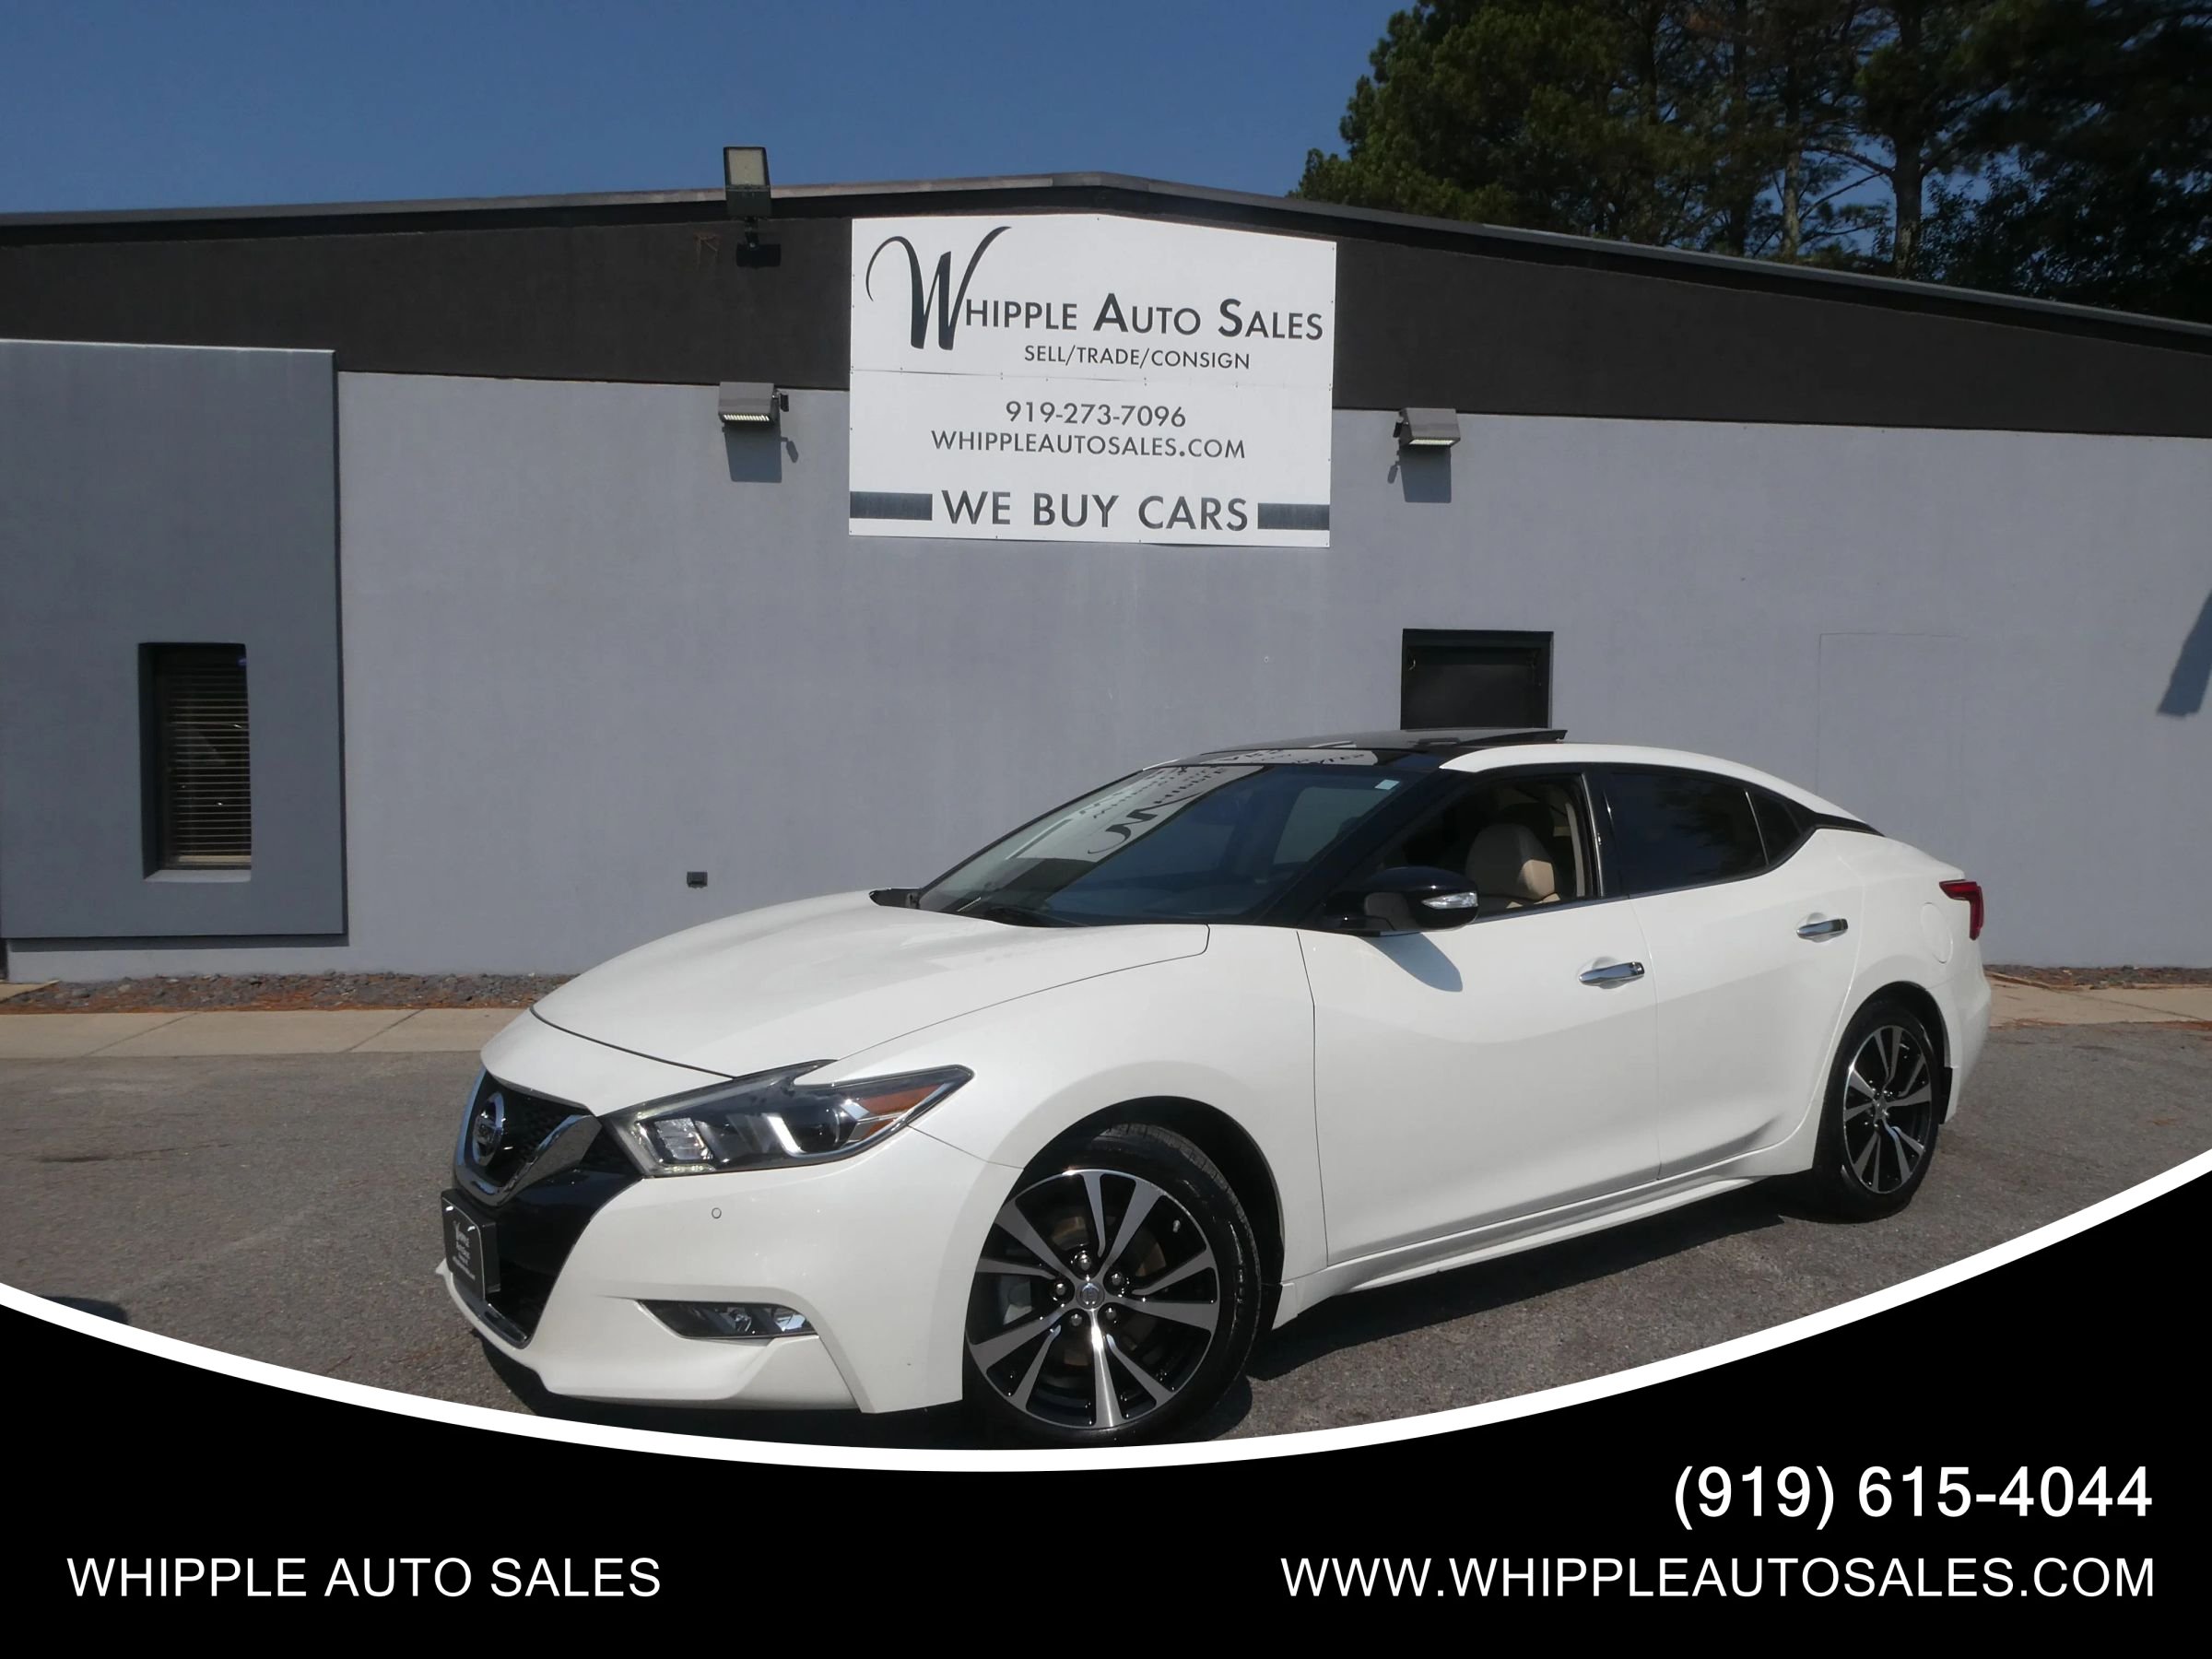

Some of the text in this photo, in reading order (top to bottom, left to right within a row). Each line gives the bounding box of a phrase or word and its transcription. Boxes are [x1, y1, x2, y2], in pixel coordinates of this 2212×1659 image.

[866, 226, 1324, 351] WHIPPLE AUTO SALES
[1024, 345, 1250, 370] SELL/TRADE/CONSIGN
[1006, 401, 1186, 428] 919-273-7096
[931, 430, 1245, 459] WHIPPLEAUTOSALES.COM
[941, 489, 1248, 532] WE BUY CARS
